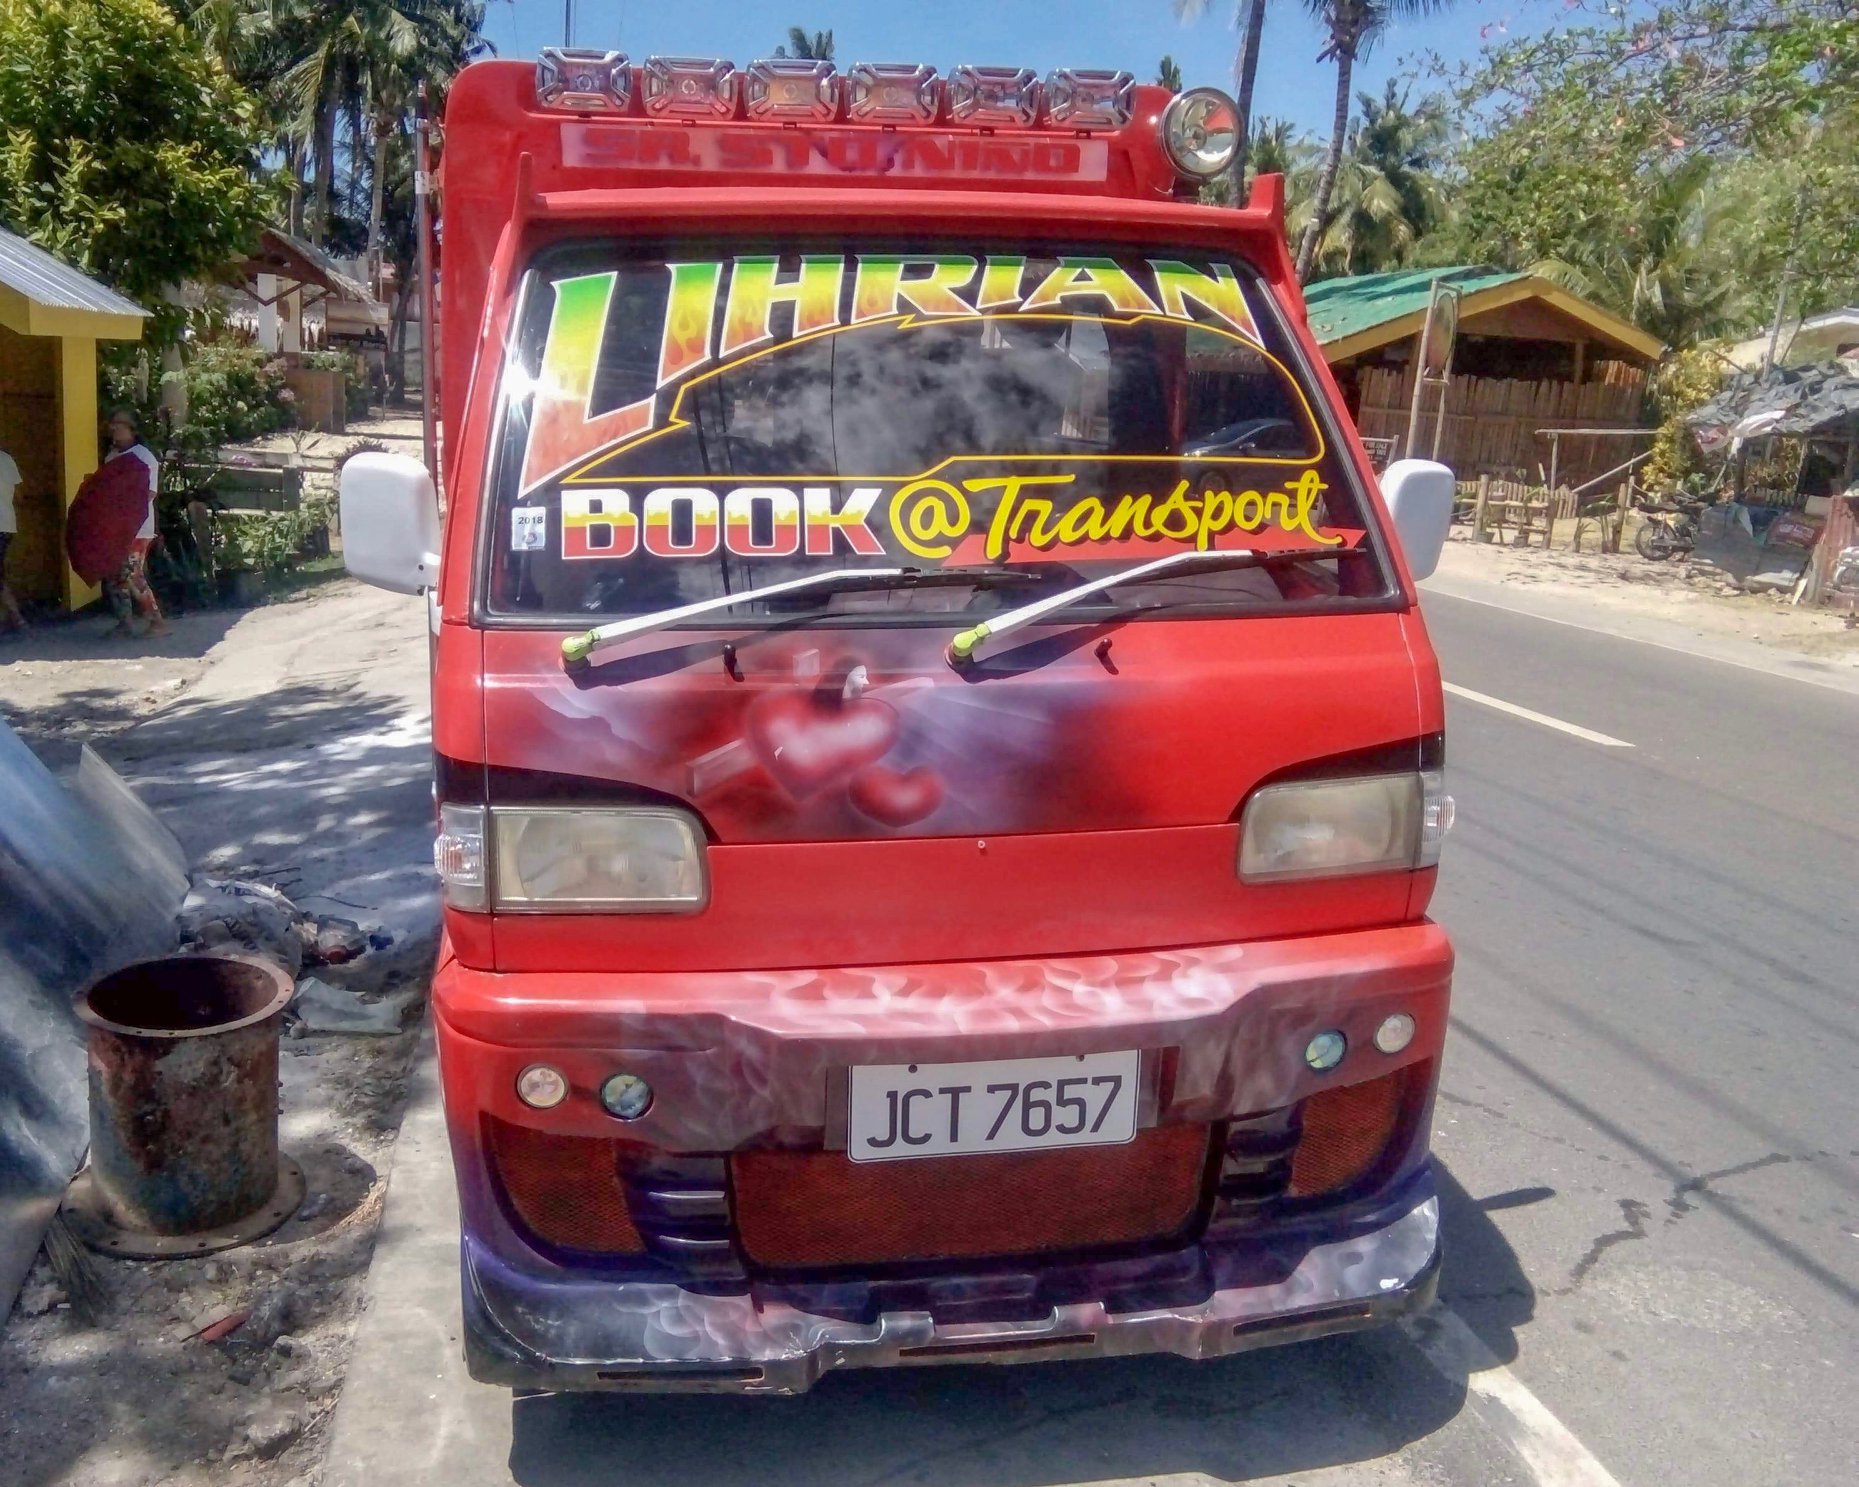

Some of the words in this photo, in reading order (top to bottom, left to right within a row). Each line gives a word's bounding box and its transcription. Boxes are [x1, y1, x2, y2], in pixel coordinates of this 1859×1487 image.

[518, 516, 544, 525] 2018
[560, 487, 887, 560] BOOK
[866, 1085, 972, 1148] JCT
[984, 1074, 1122, 1141] 7657
